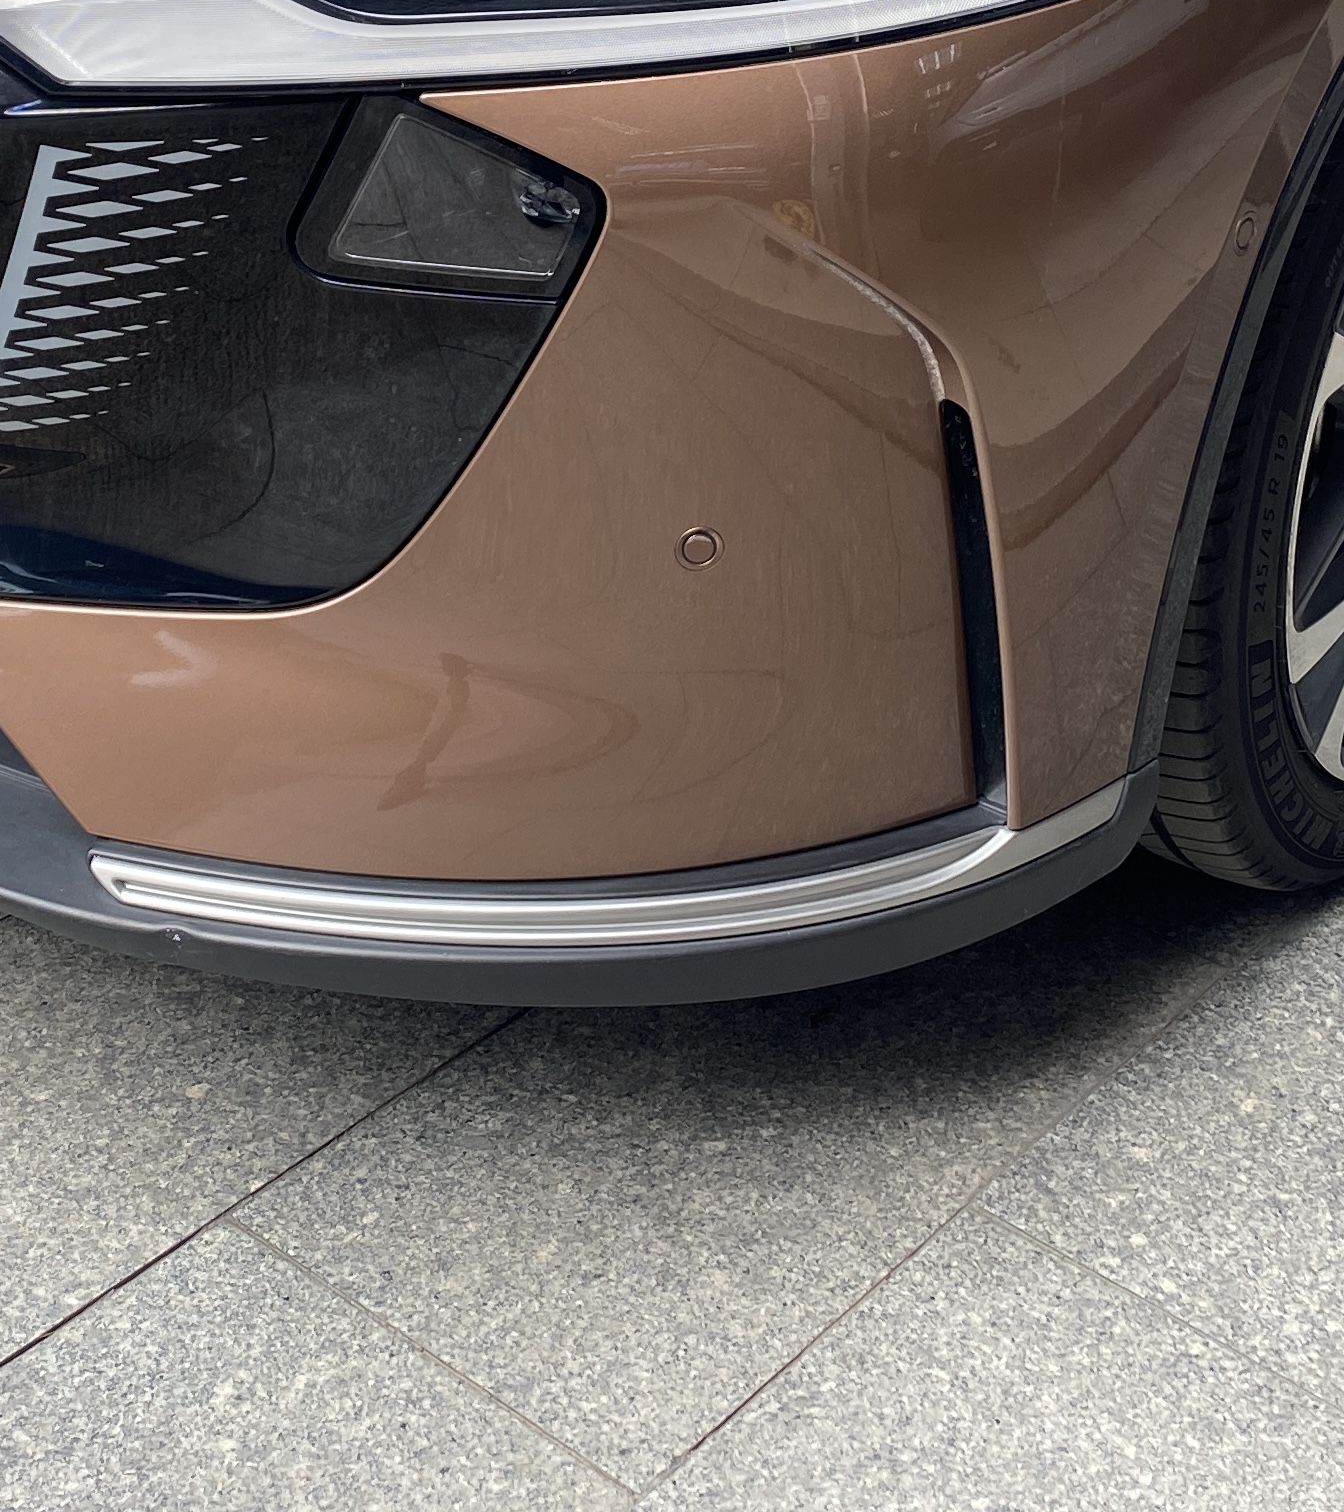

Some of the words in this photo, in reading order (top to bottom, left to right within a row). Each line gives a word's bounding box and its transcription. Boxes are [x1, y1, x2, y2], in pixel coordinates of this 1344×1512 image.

[1274, 434, 1289, 463] 19
[1268, 477, 1282, 496] R
[1253, 508, 1277, 614] 245/45
[1250, 657, 1332, 850] MICHELIN
